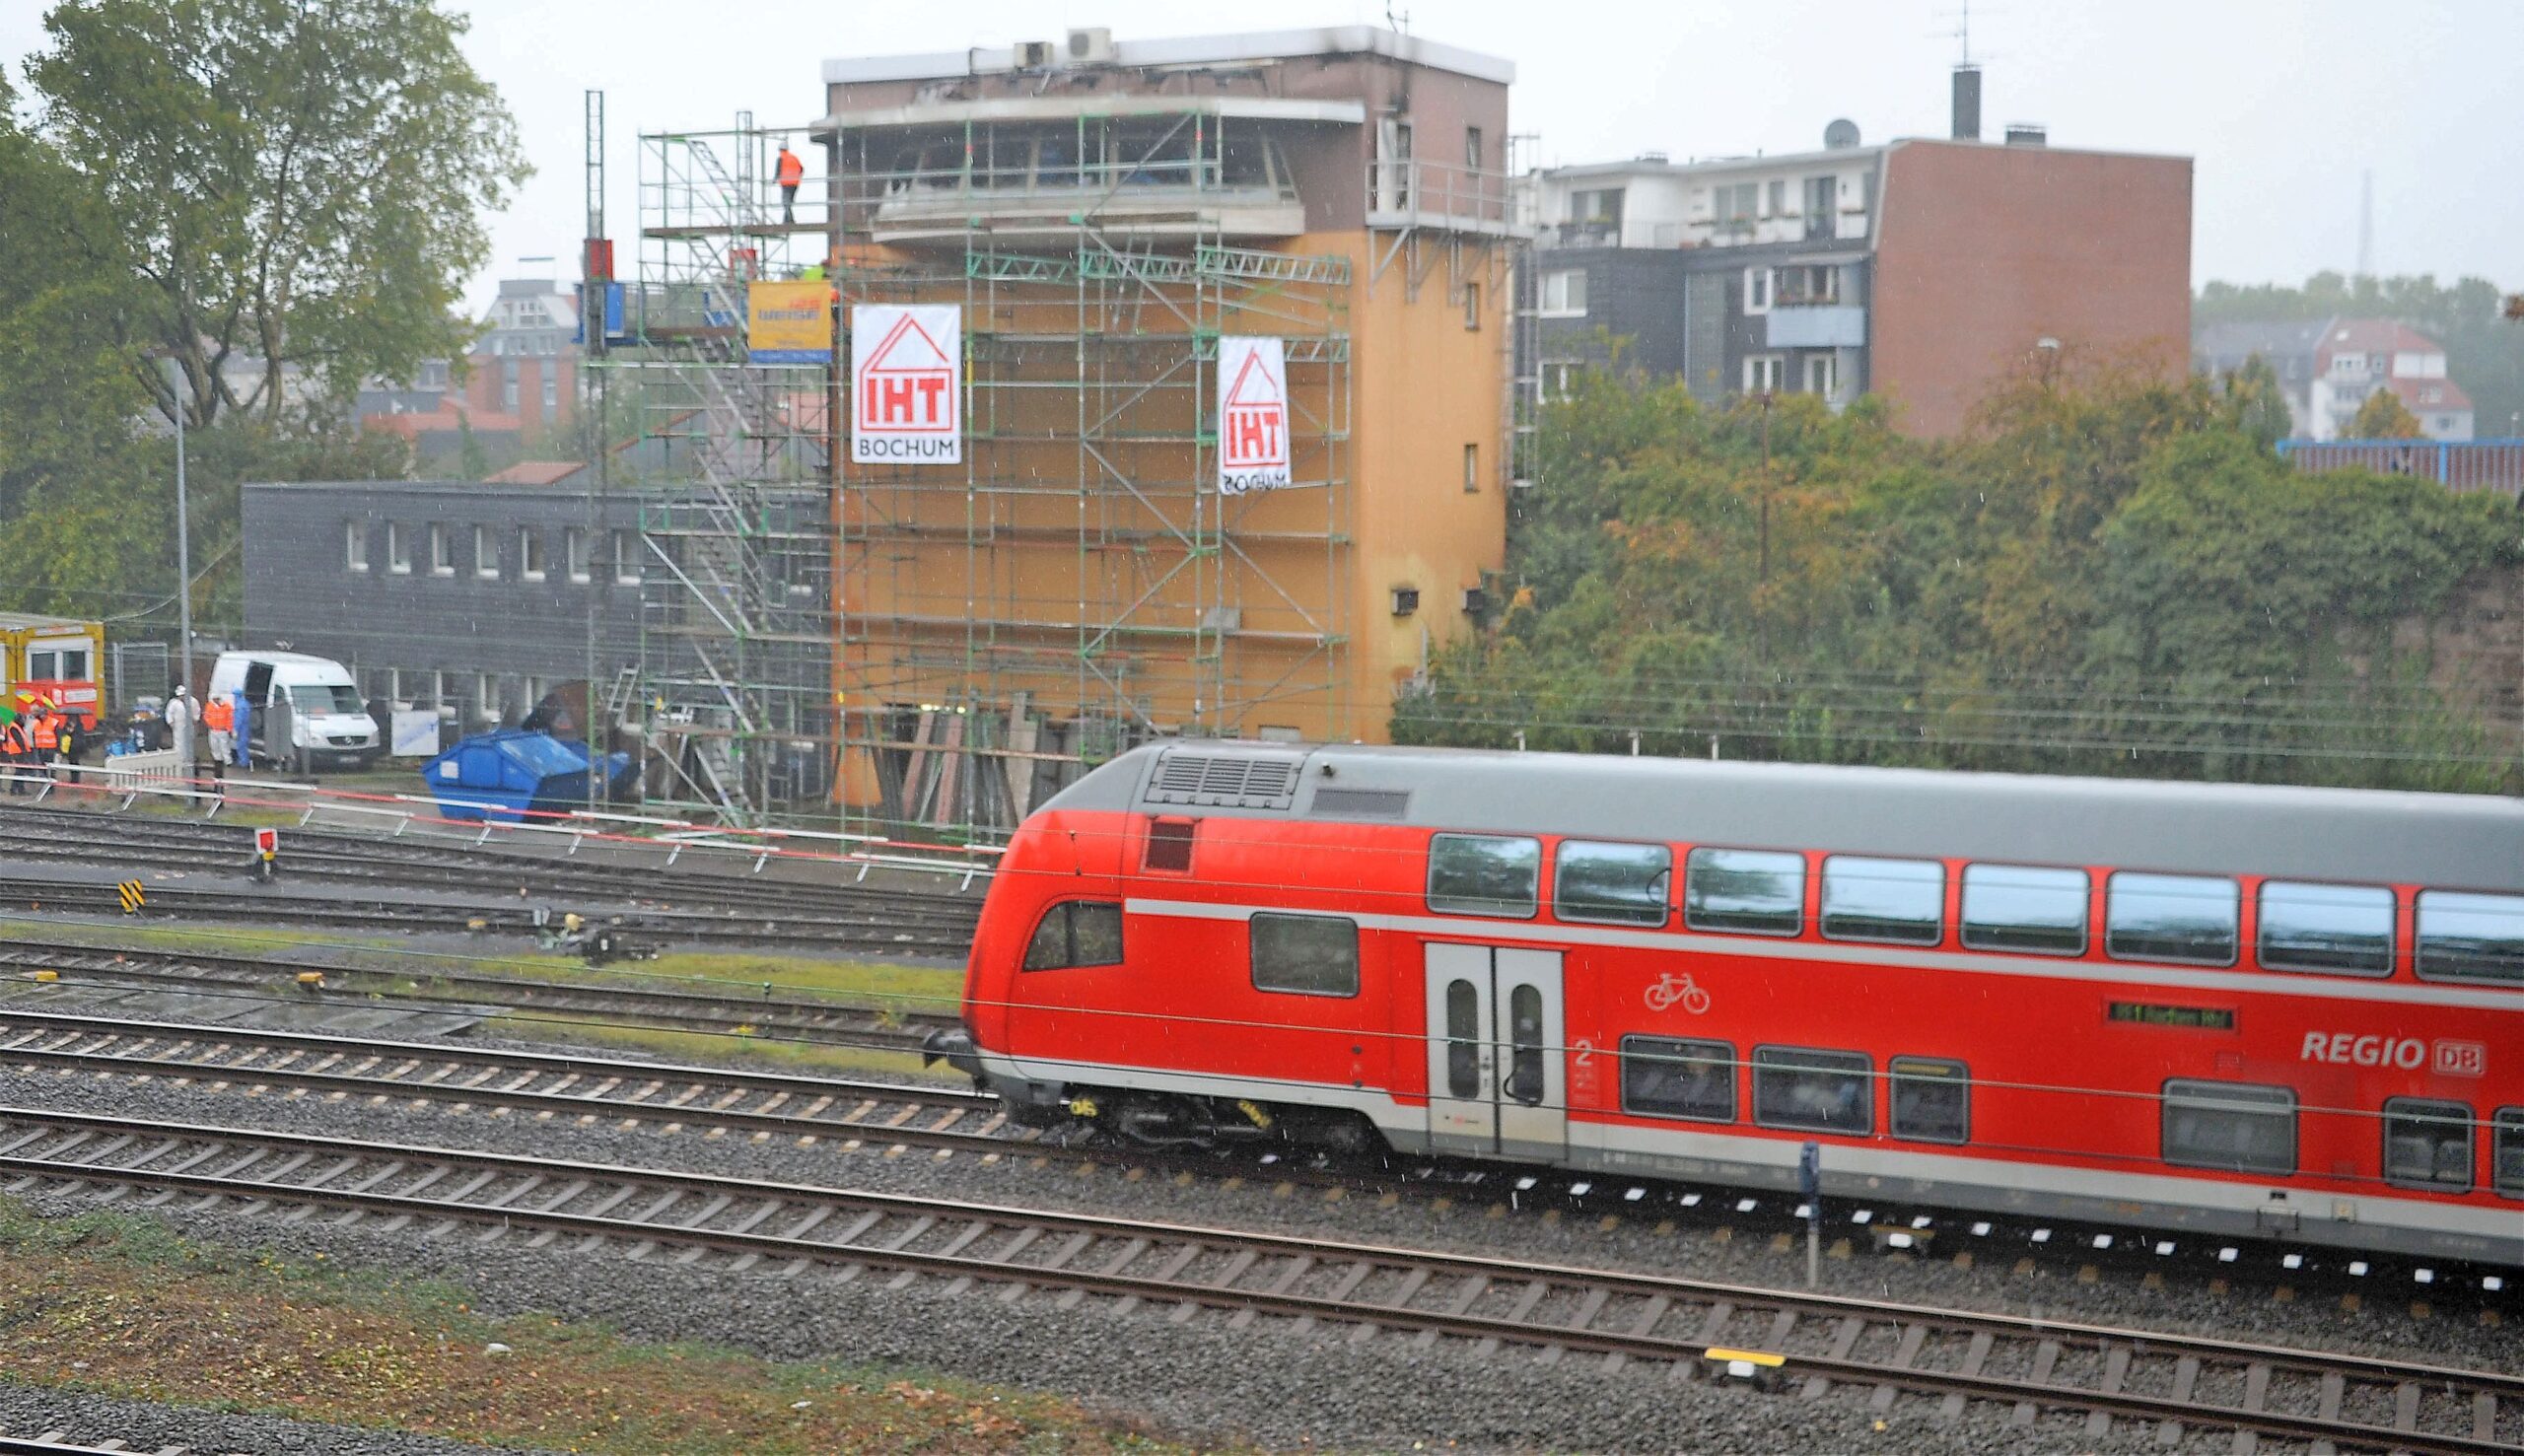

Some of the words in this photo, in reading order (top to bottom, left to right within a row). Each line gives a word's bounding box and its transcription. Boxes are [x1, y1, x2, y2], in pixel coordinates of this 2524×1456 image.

[867, 378, 946, 423] IHT
[860, 439, 954, 457] BOCHUM
[1228, 412, 1280, 458] IHT
[1576, 1039, 1593, 1067] 2
[2300, 1030, 2425, 1070] REGIO
[2438, 1045, 2479, 1071] DB
